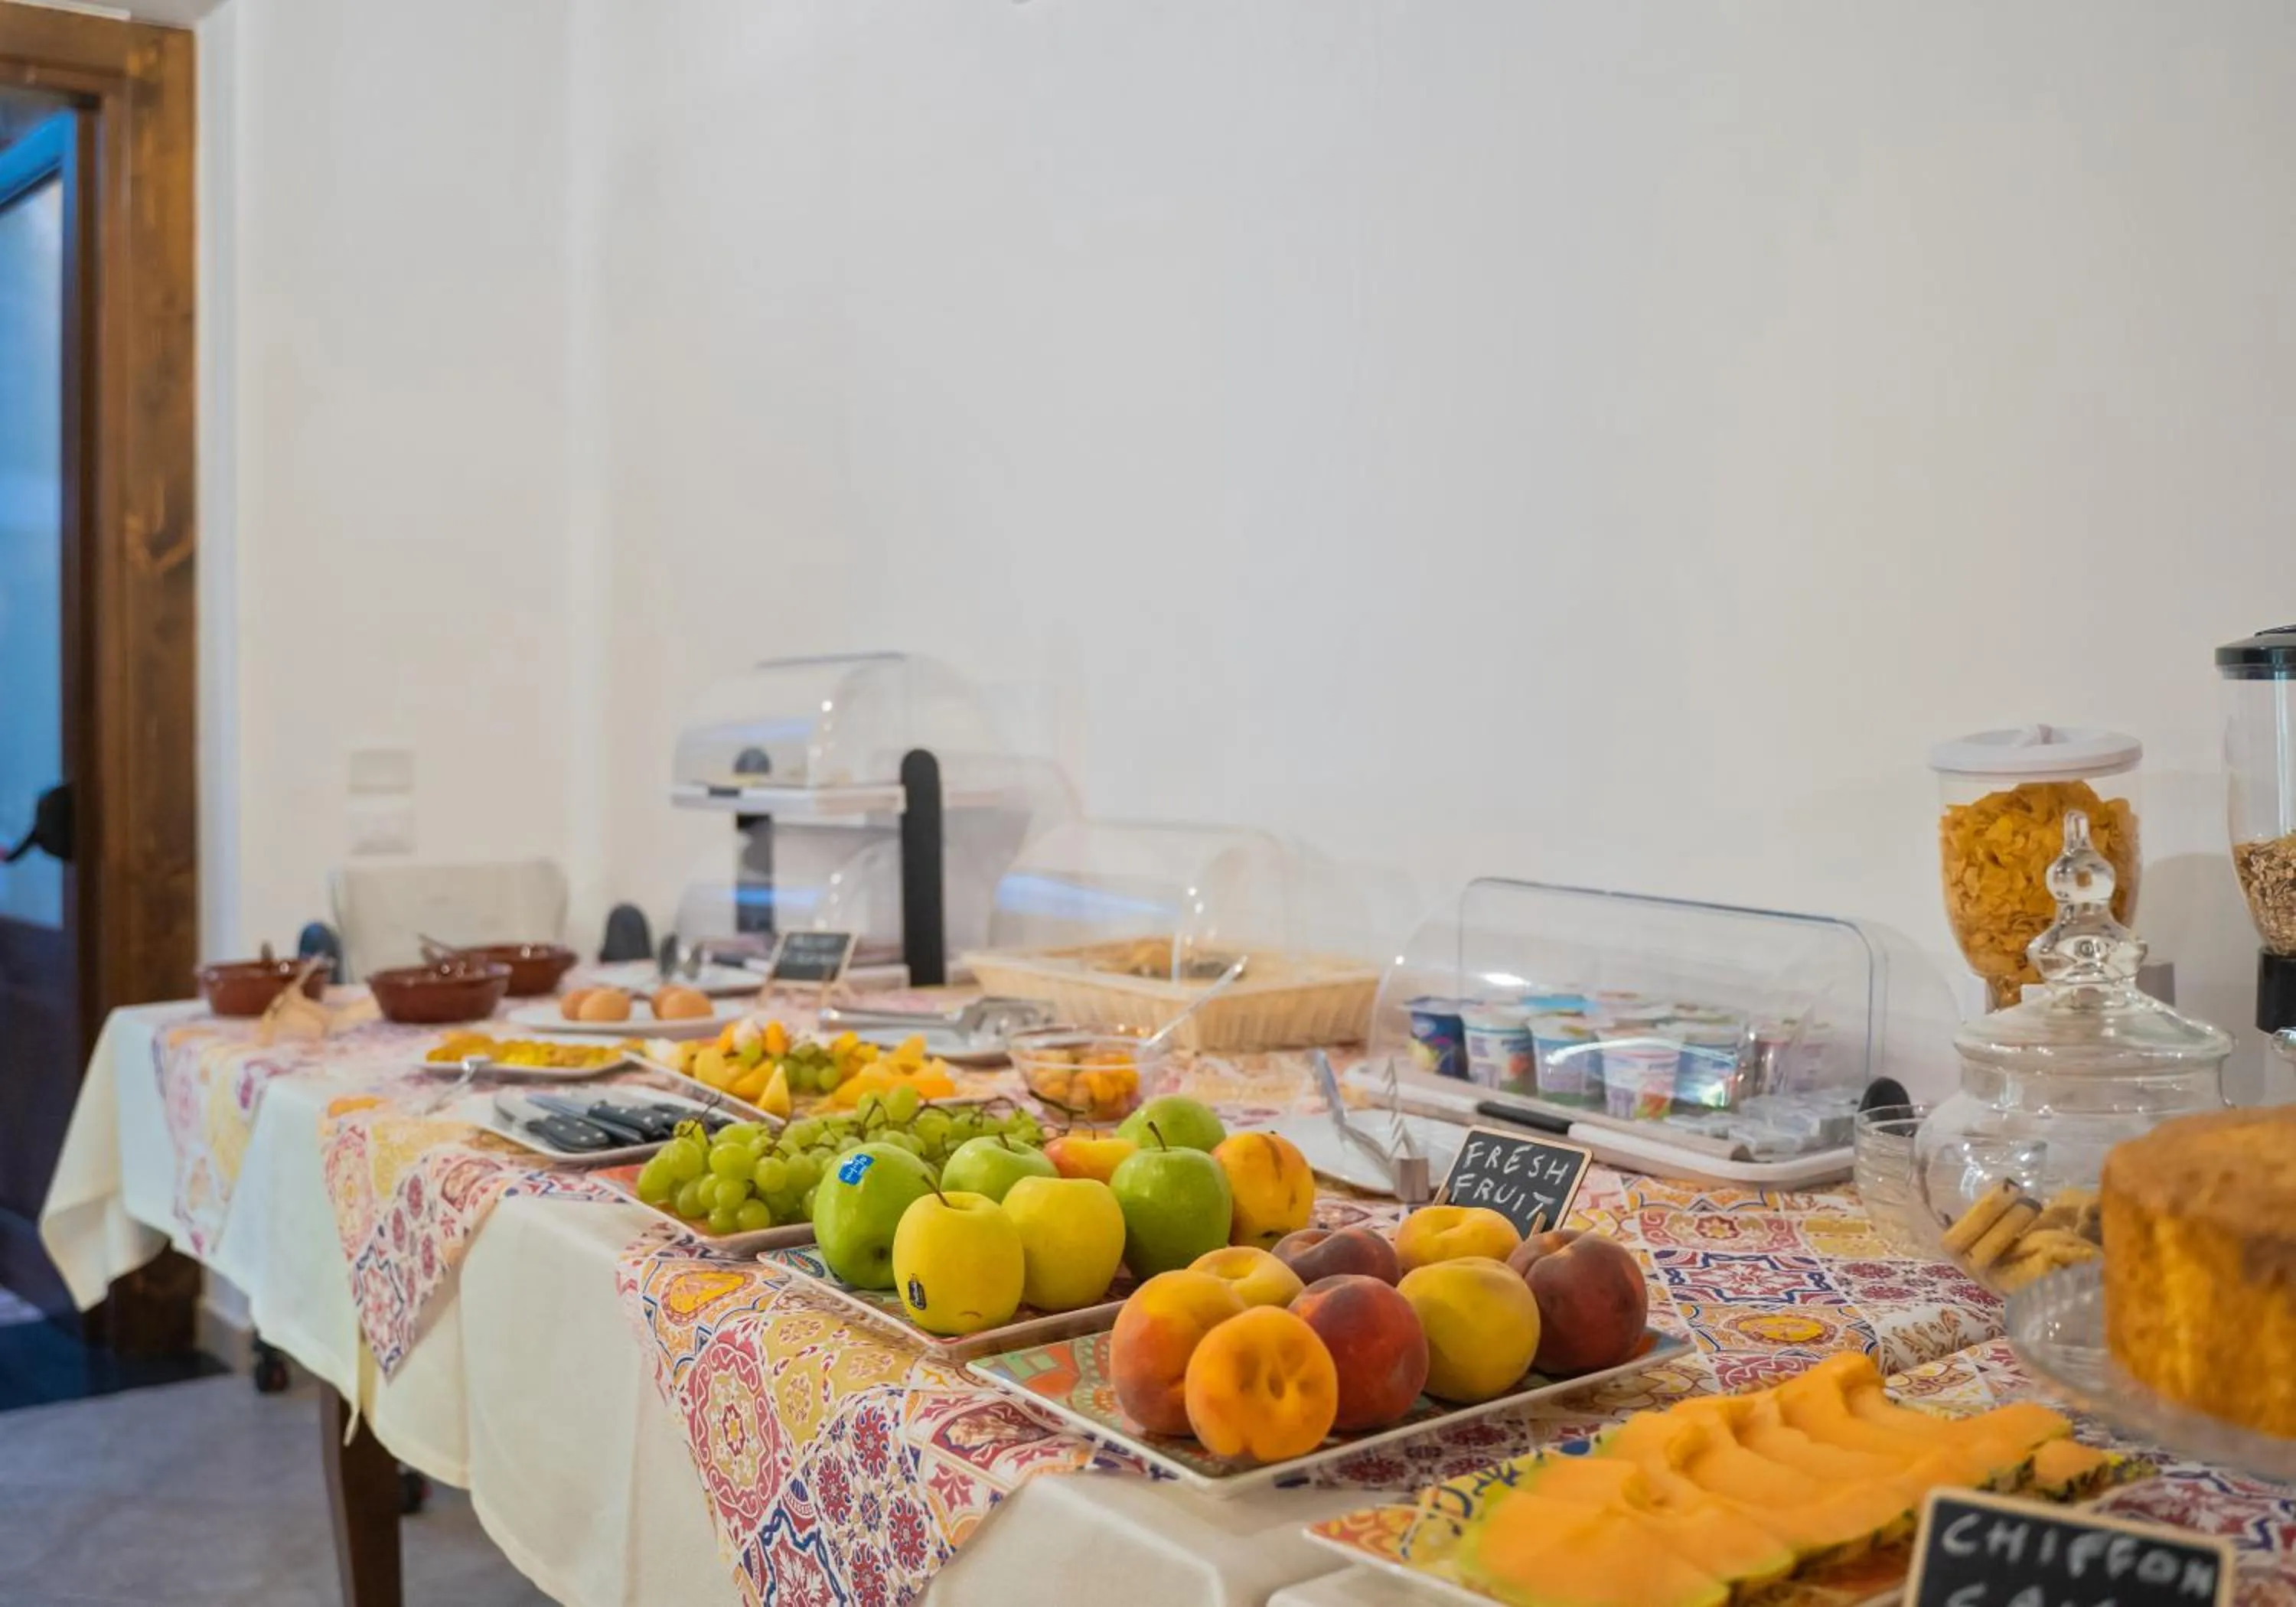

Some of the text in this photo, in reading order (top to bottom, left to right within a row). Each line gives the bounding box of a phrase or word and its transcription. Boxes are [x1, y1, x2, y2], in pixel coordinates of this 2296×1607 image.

[1463, 1140, 1570, 1185] FRESH
[1450, 1172, 1557, 1221] FRUIT
[1941, 1512, 2215, 1599] CHIFFON
